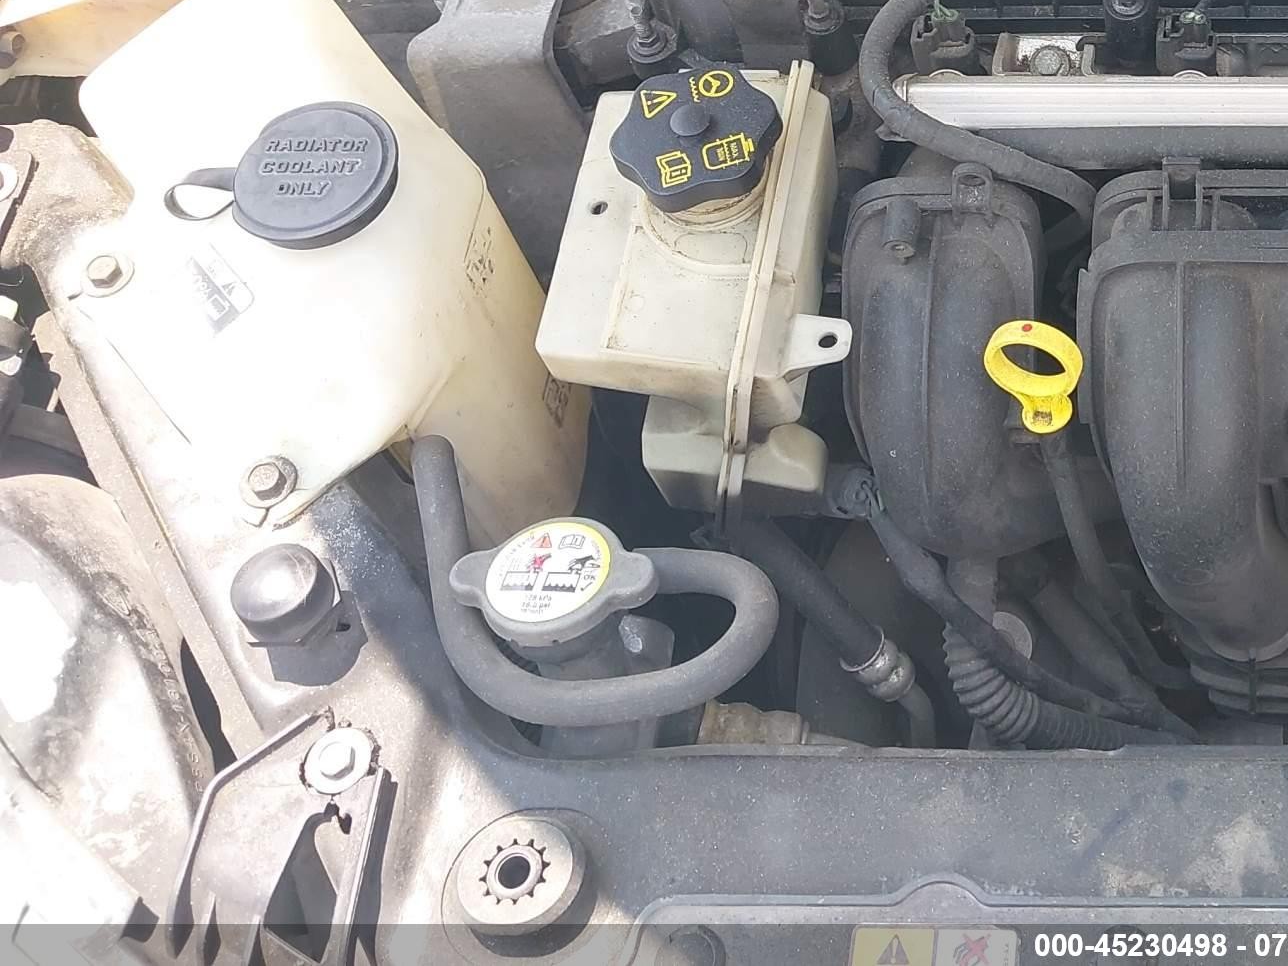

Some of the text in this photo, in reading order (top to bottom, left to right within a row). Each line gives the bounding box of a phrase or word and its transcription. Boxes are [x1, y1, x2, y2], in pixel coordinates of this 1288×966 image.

[265, 138, 369, 153] RADIATOR
[261, 159, 361, 175] COOLANT
[276, 181, 332, 196] ONLY
